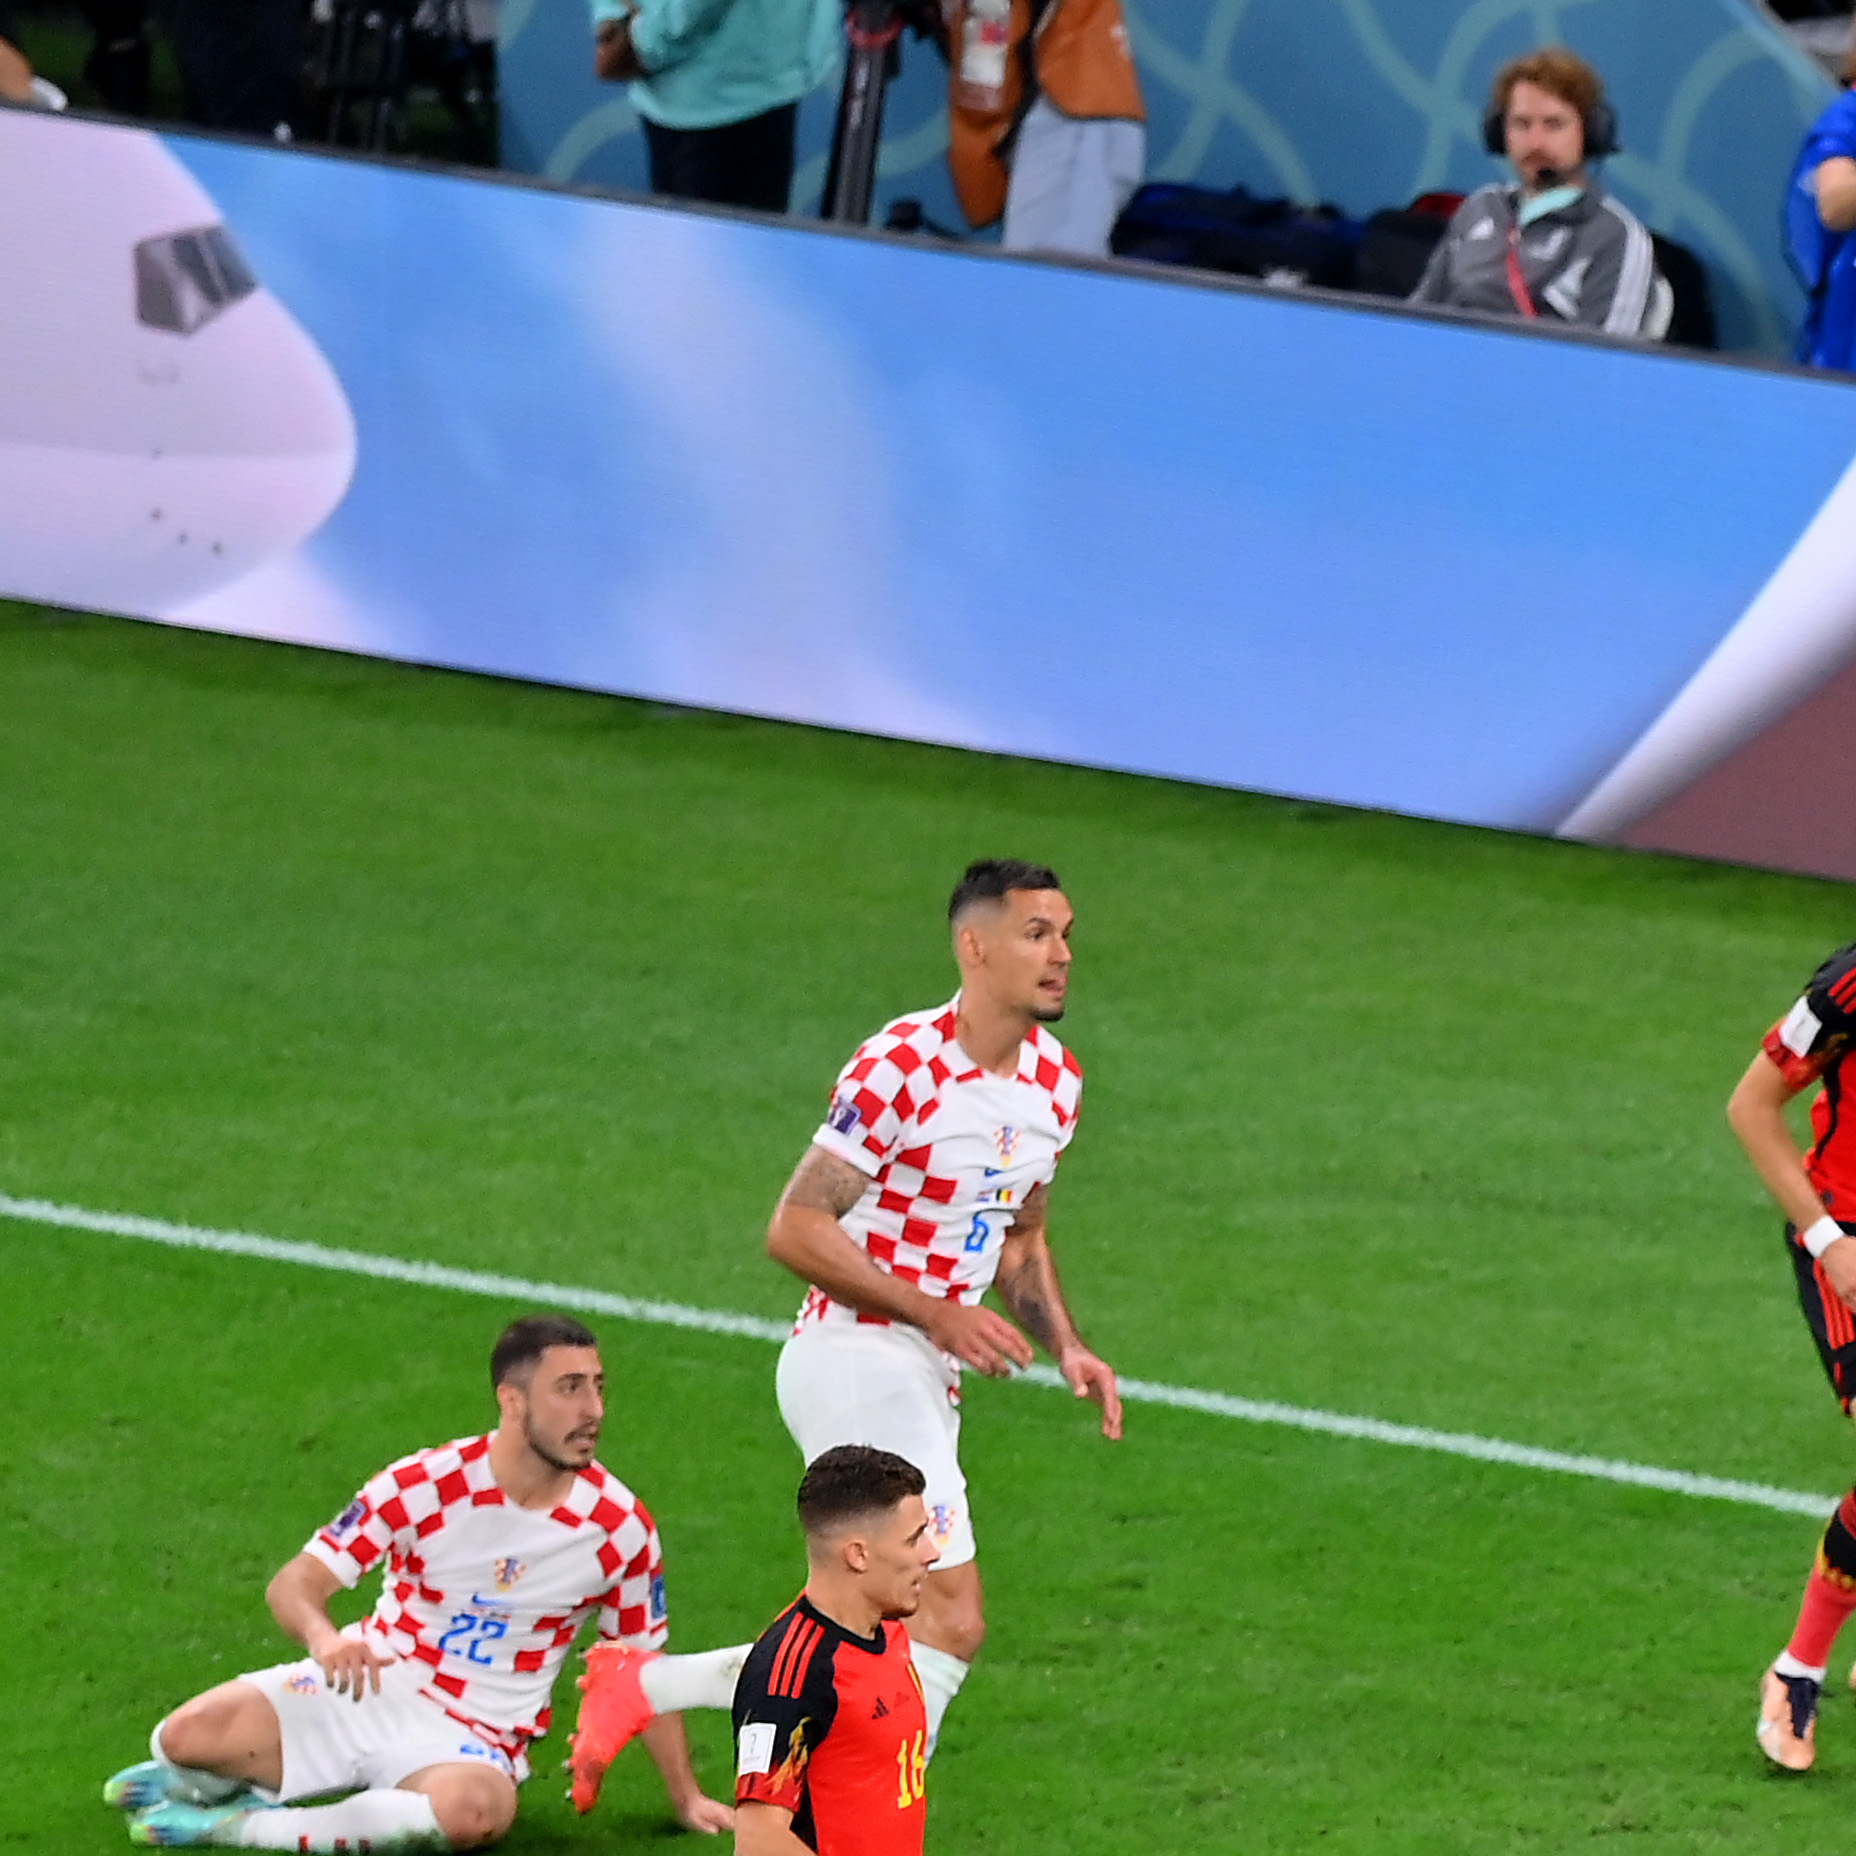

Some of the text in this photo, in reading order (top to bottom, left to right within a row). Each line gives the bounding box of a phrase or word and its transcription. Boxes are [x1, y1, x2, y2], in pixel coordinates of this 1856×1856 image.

[965, 1210, 989, 1252] 6
[438, 1613, 508, 1665] 22
[897, 1729, 925, 1810] 16
